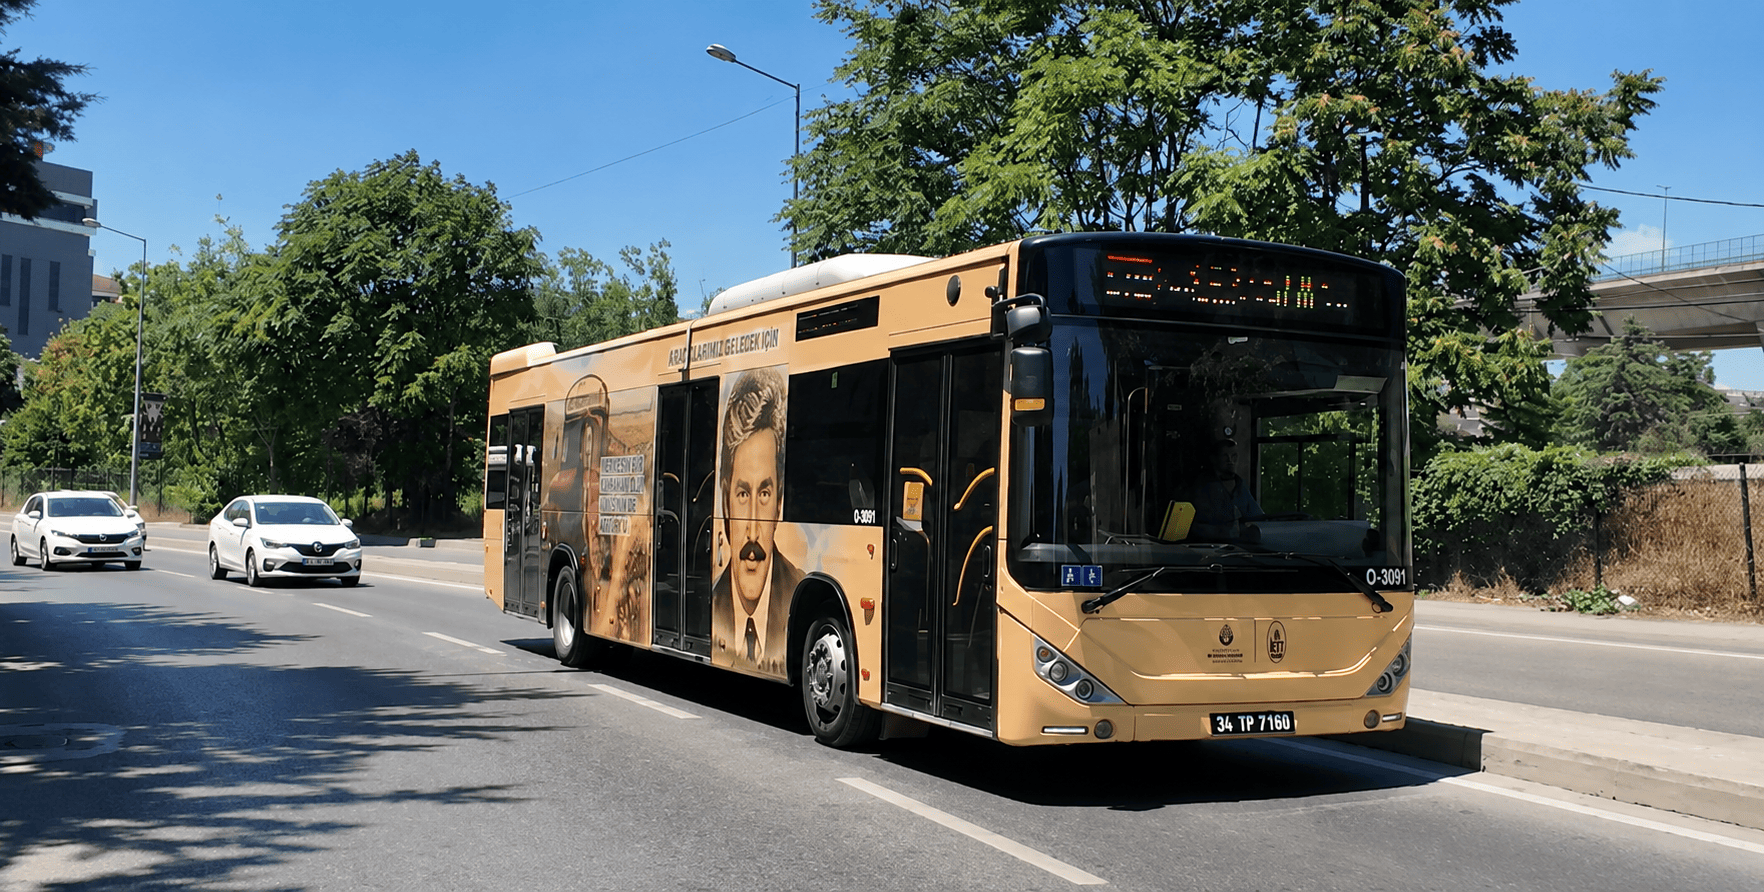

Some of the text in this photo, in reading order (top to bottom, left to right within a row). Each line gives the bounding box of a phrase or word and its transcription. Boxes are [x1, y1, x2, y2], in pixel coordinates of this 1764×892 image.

[1366, 568, 1406, 586] O-3091
[1216, 714, 1291, 733] 34 TP 7160
